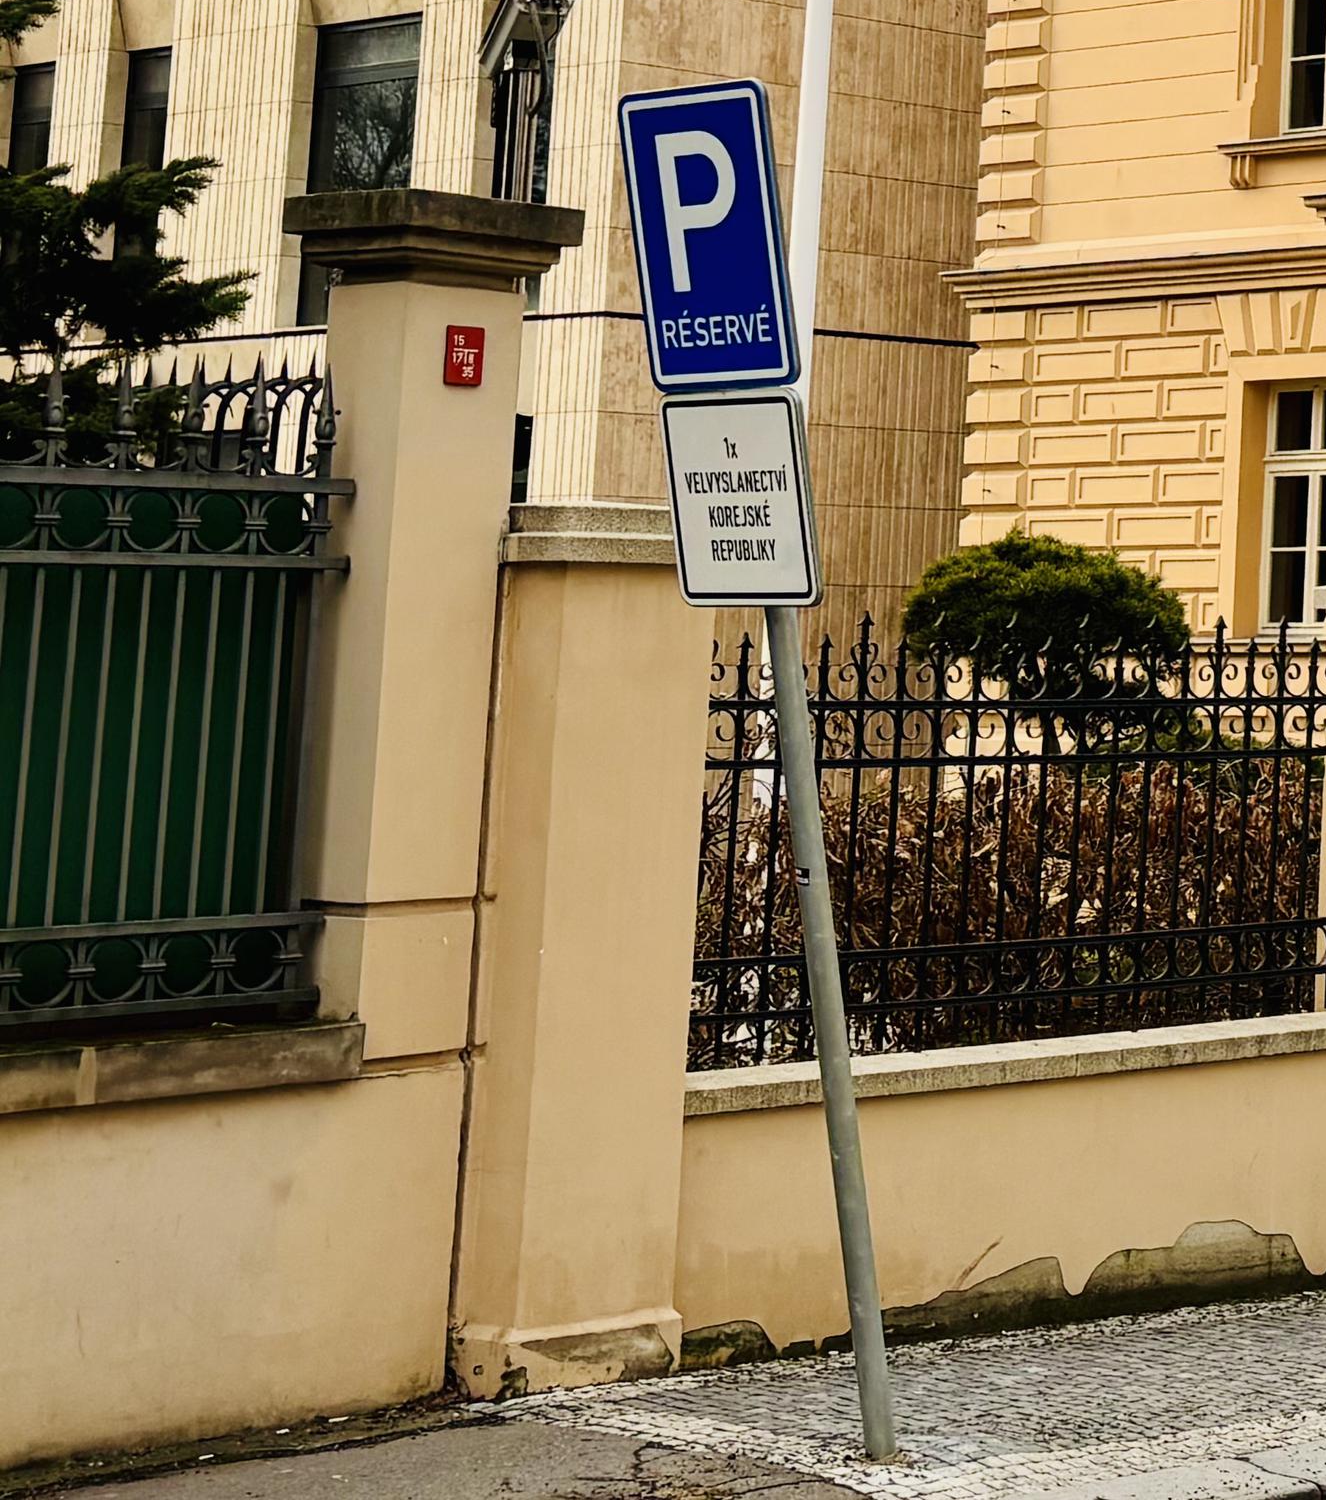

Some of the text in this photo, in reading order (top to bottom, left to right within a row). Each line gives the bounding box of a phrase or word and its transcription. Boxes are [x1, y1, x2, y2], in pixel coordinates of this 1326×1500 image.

[654, 130, 736, 293] P
[454, 334, 465, 346] 15
[661, 304, 773, 349] RÉSERVÉ
[723, 436, 738, 459] 1x
[684, 463, 787, 494] VELVYSLANECTVÍ
[708, 499, 771, 528] KOREJSKÉ
[711, 538, 776, 562] REPUBLIKY
